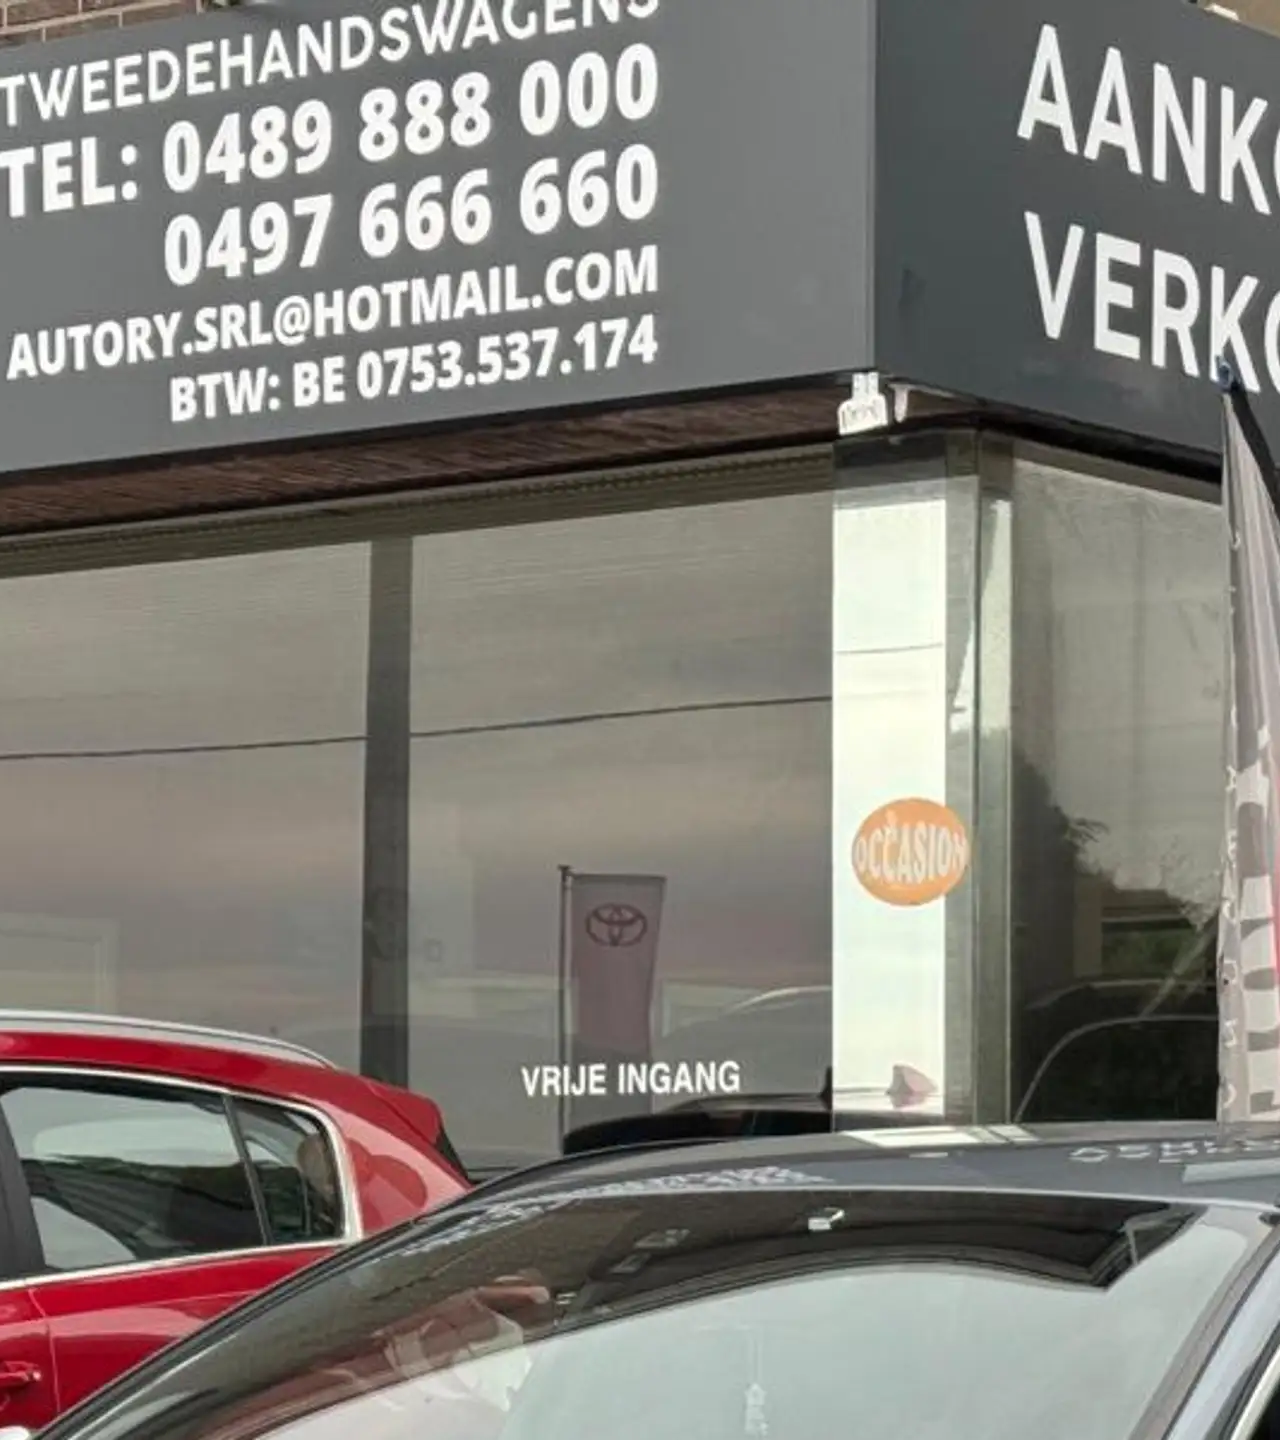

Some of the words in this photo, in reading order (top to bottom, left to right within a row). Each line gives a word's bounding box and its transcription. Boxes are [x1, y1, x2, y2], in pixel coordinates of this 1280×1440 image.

[163, 99, 333, 193] 0489
[359, 72, 491, 162] 888
[519, 43, 659, 137] 000
[164, 193, 334, 286] 0497
[359, 169, 492, 258] 666
[519, 143, 659, 235] 660
[6, 244, 659, 380] AUTORY.SRL@HOTMAIL.COM
[170, 363, 280, 423] BTW:
[292, 355, 346, 408] BE
[356, 314, 658, 399] 0753.537.174
[854, 820, 968, 885] OCCASION
[521, 1062, 608, 1098] VRIJE
[618, 1060, 742, 1095] INGANG
